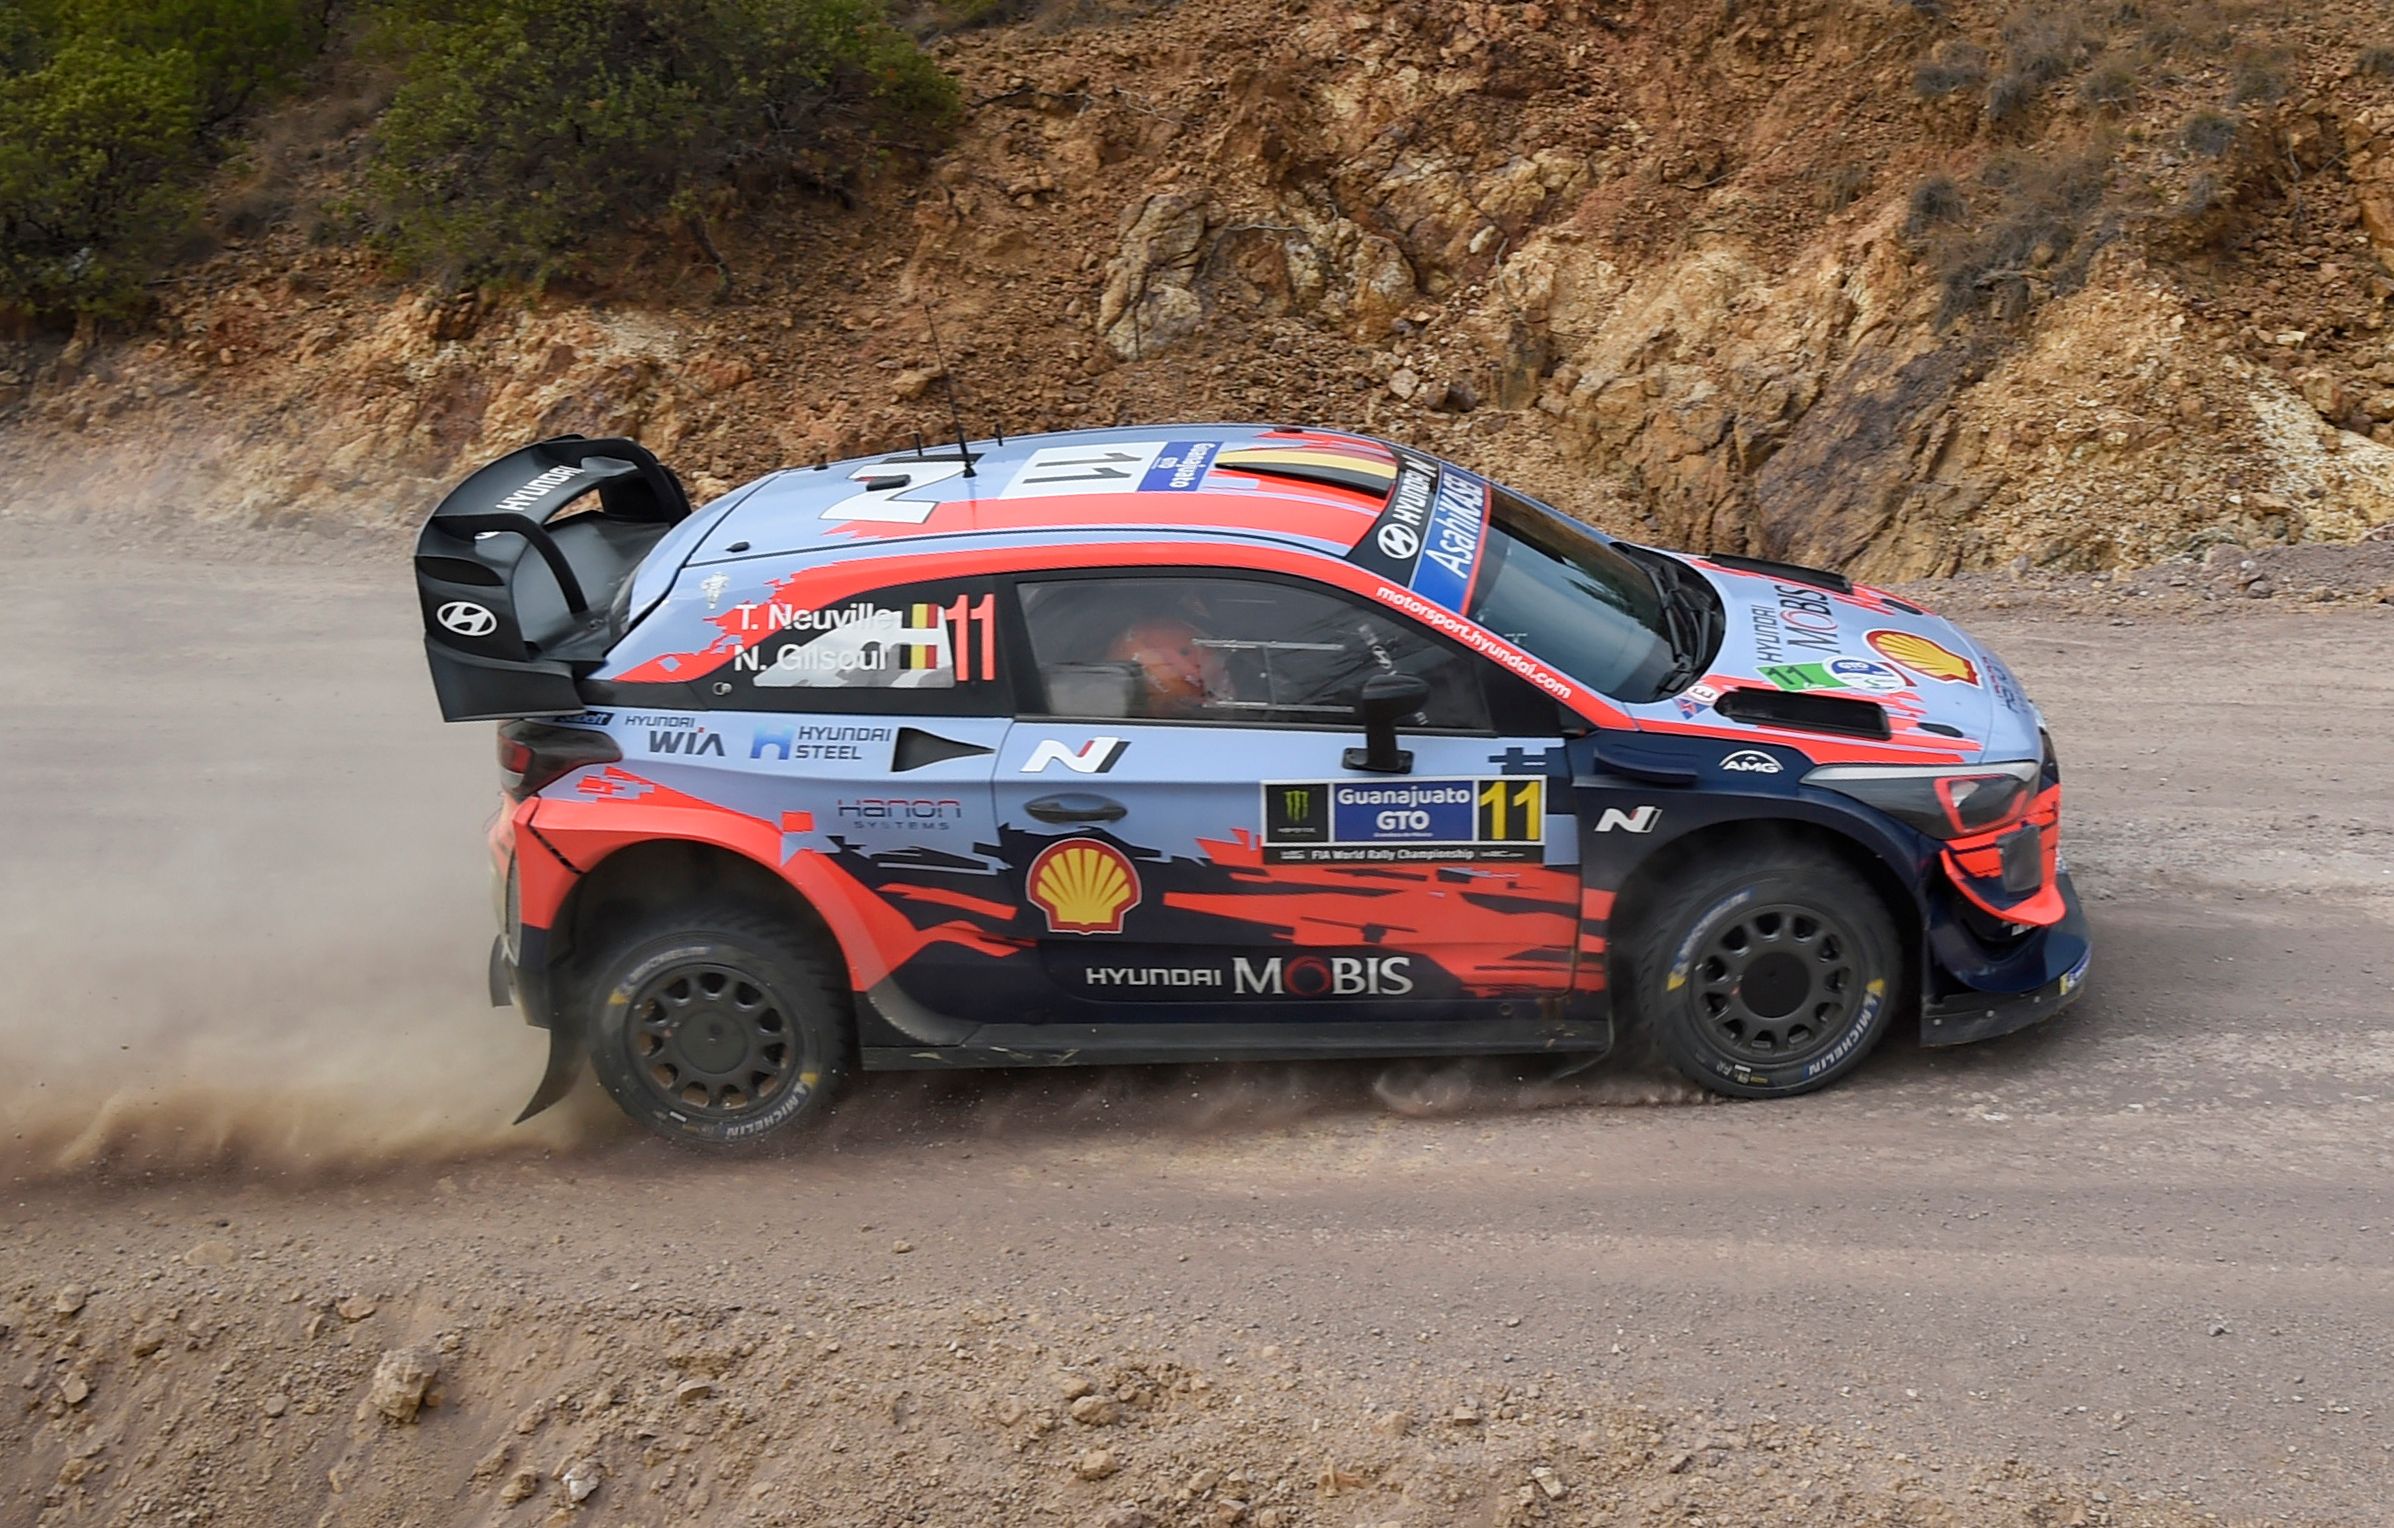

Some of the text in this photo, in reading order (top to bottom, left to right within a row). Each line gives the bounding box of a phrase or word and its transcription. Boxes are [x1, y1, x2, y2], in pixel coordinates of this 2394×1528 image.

[1022, 452, 1143, 484] 11
[495, 464, 586, 512] HYUNDAI
[735, 602, 903, 630] T. Neuville
[1773, 585, 1842, 655] MOBIS
[945, 593, 996, 682] 11
[1375, 585, 1572, 700] motorsport.hyundai.com
[1750, 604, 1784, 664] HYUNDAI
[733, 643, 887, 672] N. Gilsoul
[1767, 665, 1815, 685] 11
[624, 715, 696, 728] HYUNDAI
[798, 726, 892, 742] HYUNDAI
[649, 727, 726, 757] WIA
[795, 745, 862, 760] STEEL
[1722, 761, 1780, 774] AMG
[1337, 786, 1471, 808] Guanajuato
[1479, 781, 1541, 840] 11
[854, 821, 950, 831] SYSTEMS
[1376, 810, 1431, 830] GTO
[1311, 851, 1331, 859] FIA
[1333, 850, 1366, 860] World
[1367, 849, 1396, 860] Rally
[1397, 849, 1475, 860] Championship
[1086, 956, 1413, 997] HYUNDAI MOBIS
[1808, 1008, 1872, 1076] MICHELIN
[726, 1094, 798, 1137] MICHELIN
